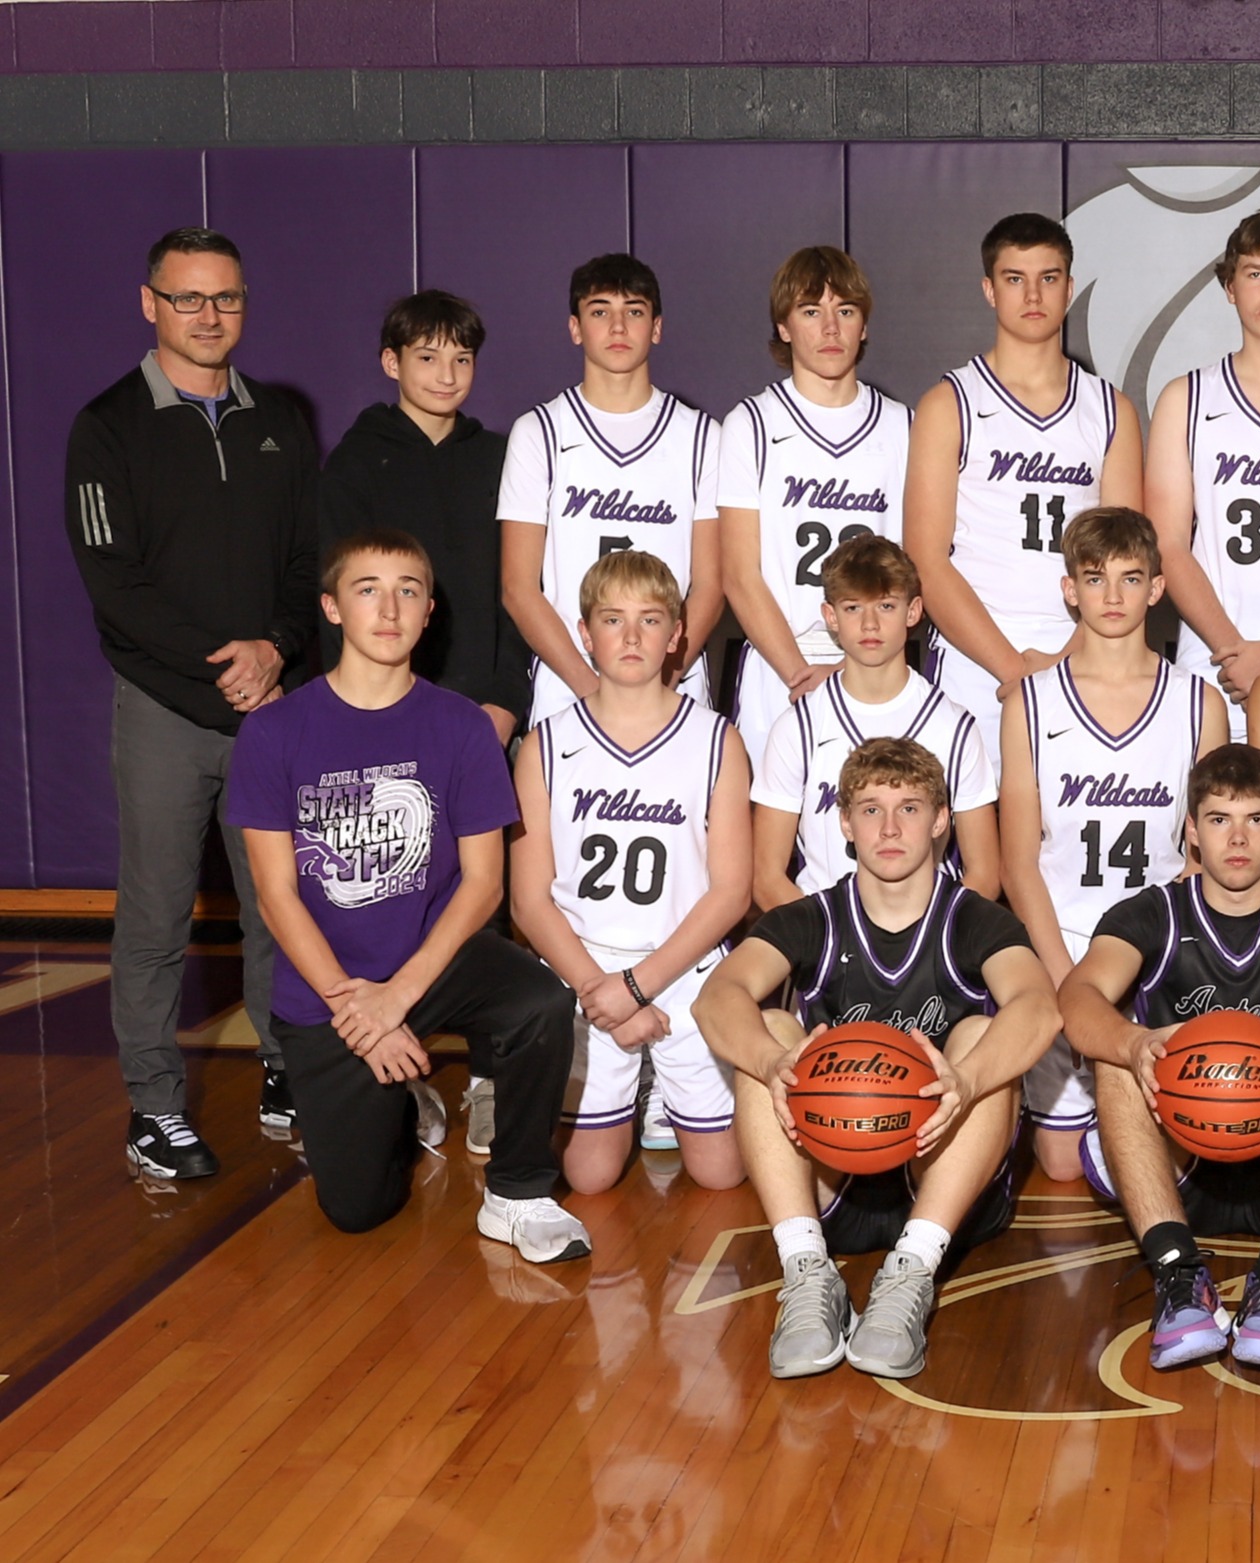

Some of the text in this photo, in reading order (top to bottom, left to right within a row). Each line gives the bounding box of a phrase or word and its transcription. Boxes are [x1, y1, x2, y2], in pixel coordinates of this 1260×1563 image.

[988, 450, 1094, 486] Wildcats
[561, 485, 677, 525] Wildcats
[782, 475, 888, 513] Wildcats
[1020, 493, 1066, 554] 11
[319, 761, 418, 787] AXTELL WILDCATS
[1058, 773, 1174, 807] Wildcats
[297, 782, 376, 825] STATE
[572, 788, 686, 825] Wildcats
[321, 807, 406, 850] TRACK
[578, 833, 667, 905] 20
[1080, 820, 1150, 888] 14
[373, 868, 427, 899] 2024
[808, 1051, 910, 1080] Baden
